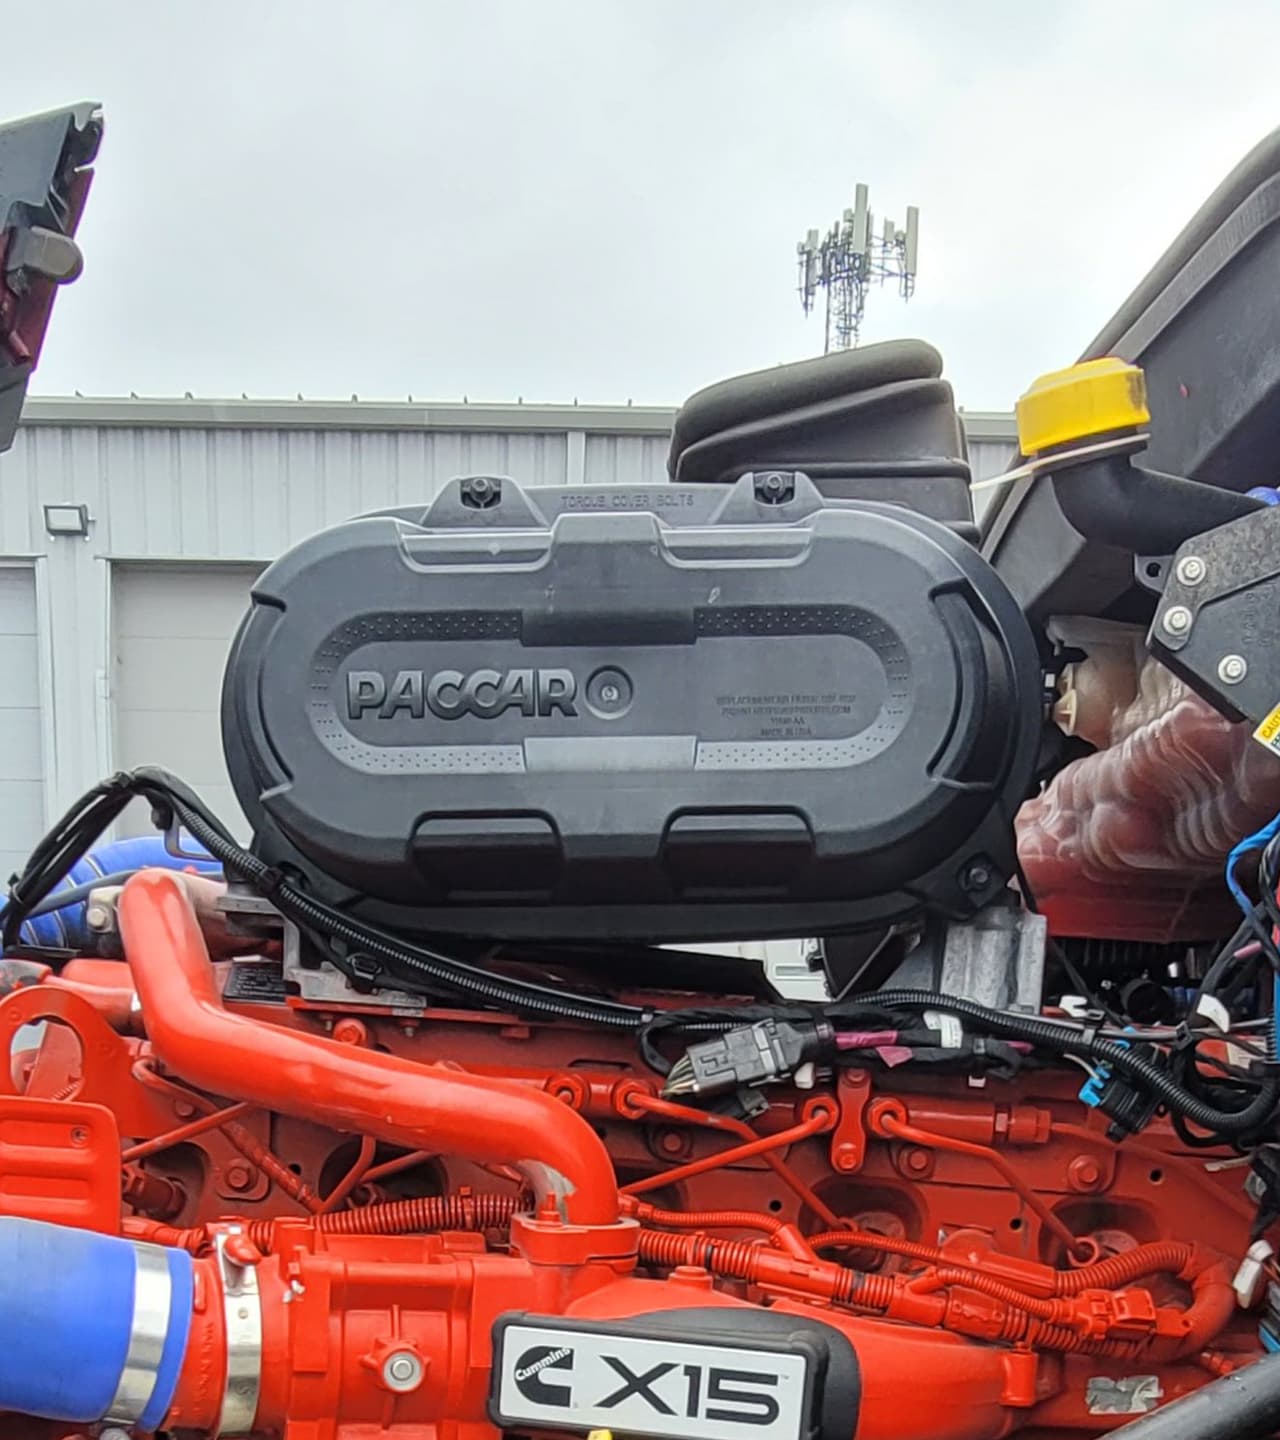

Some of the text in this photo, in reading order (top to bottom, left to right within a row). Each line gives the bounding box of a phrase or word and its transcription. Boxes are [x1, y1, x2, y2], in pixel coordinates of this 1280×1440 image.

[561, 494, 694, 508] TORQUE COVER BOLTS
[347, 669, 578, 720] PACCAR
[515, 1346, 571, 1380] Cummins
[592, 1354, 780, 1426] X15
